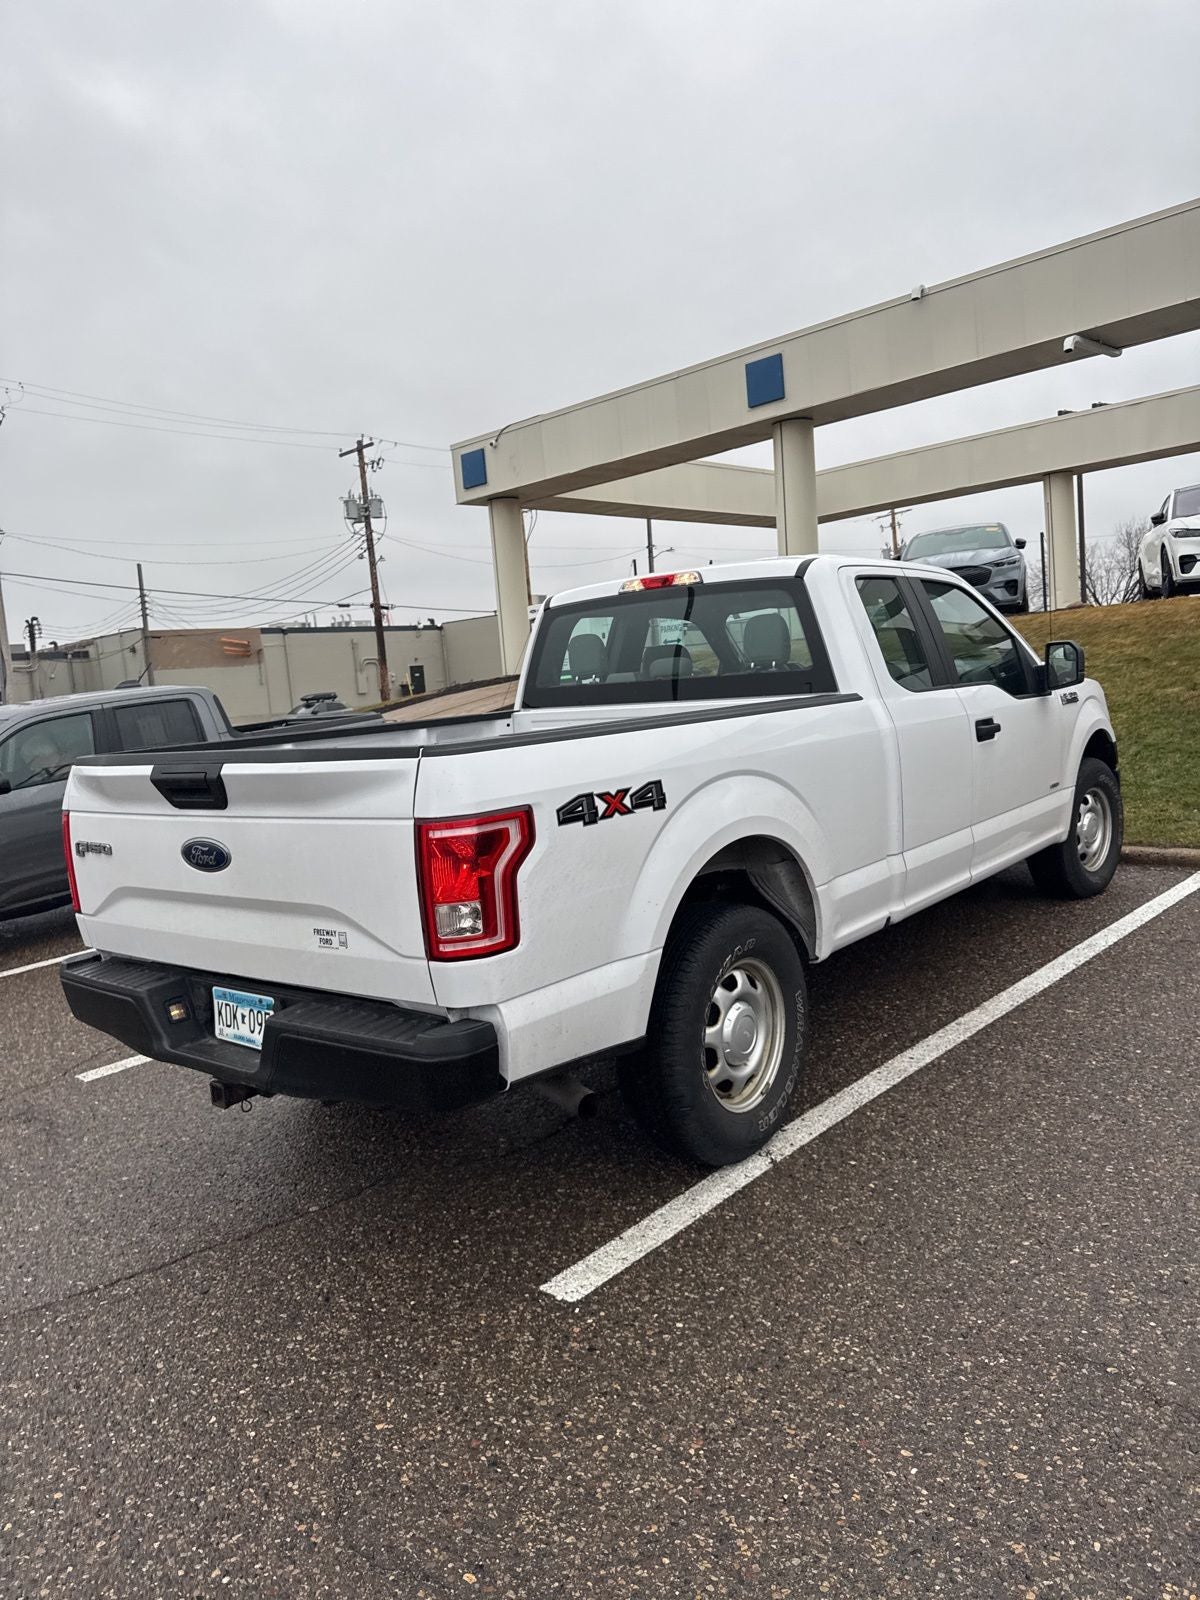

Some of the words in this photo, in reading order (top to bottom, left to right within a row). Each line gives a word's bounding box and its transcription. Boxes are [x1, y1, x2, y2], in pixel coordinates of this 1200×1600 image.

[190, 845, 217, 865] Ford
[313, 928, 337, 938] FREEWAY
[319, 937, 333, 946] FORD
[217, 1001, 240, 1031] KDK
